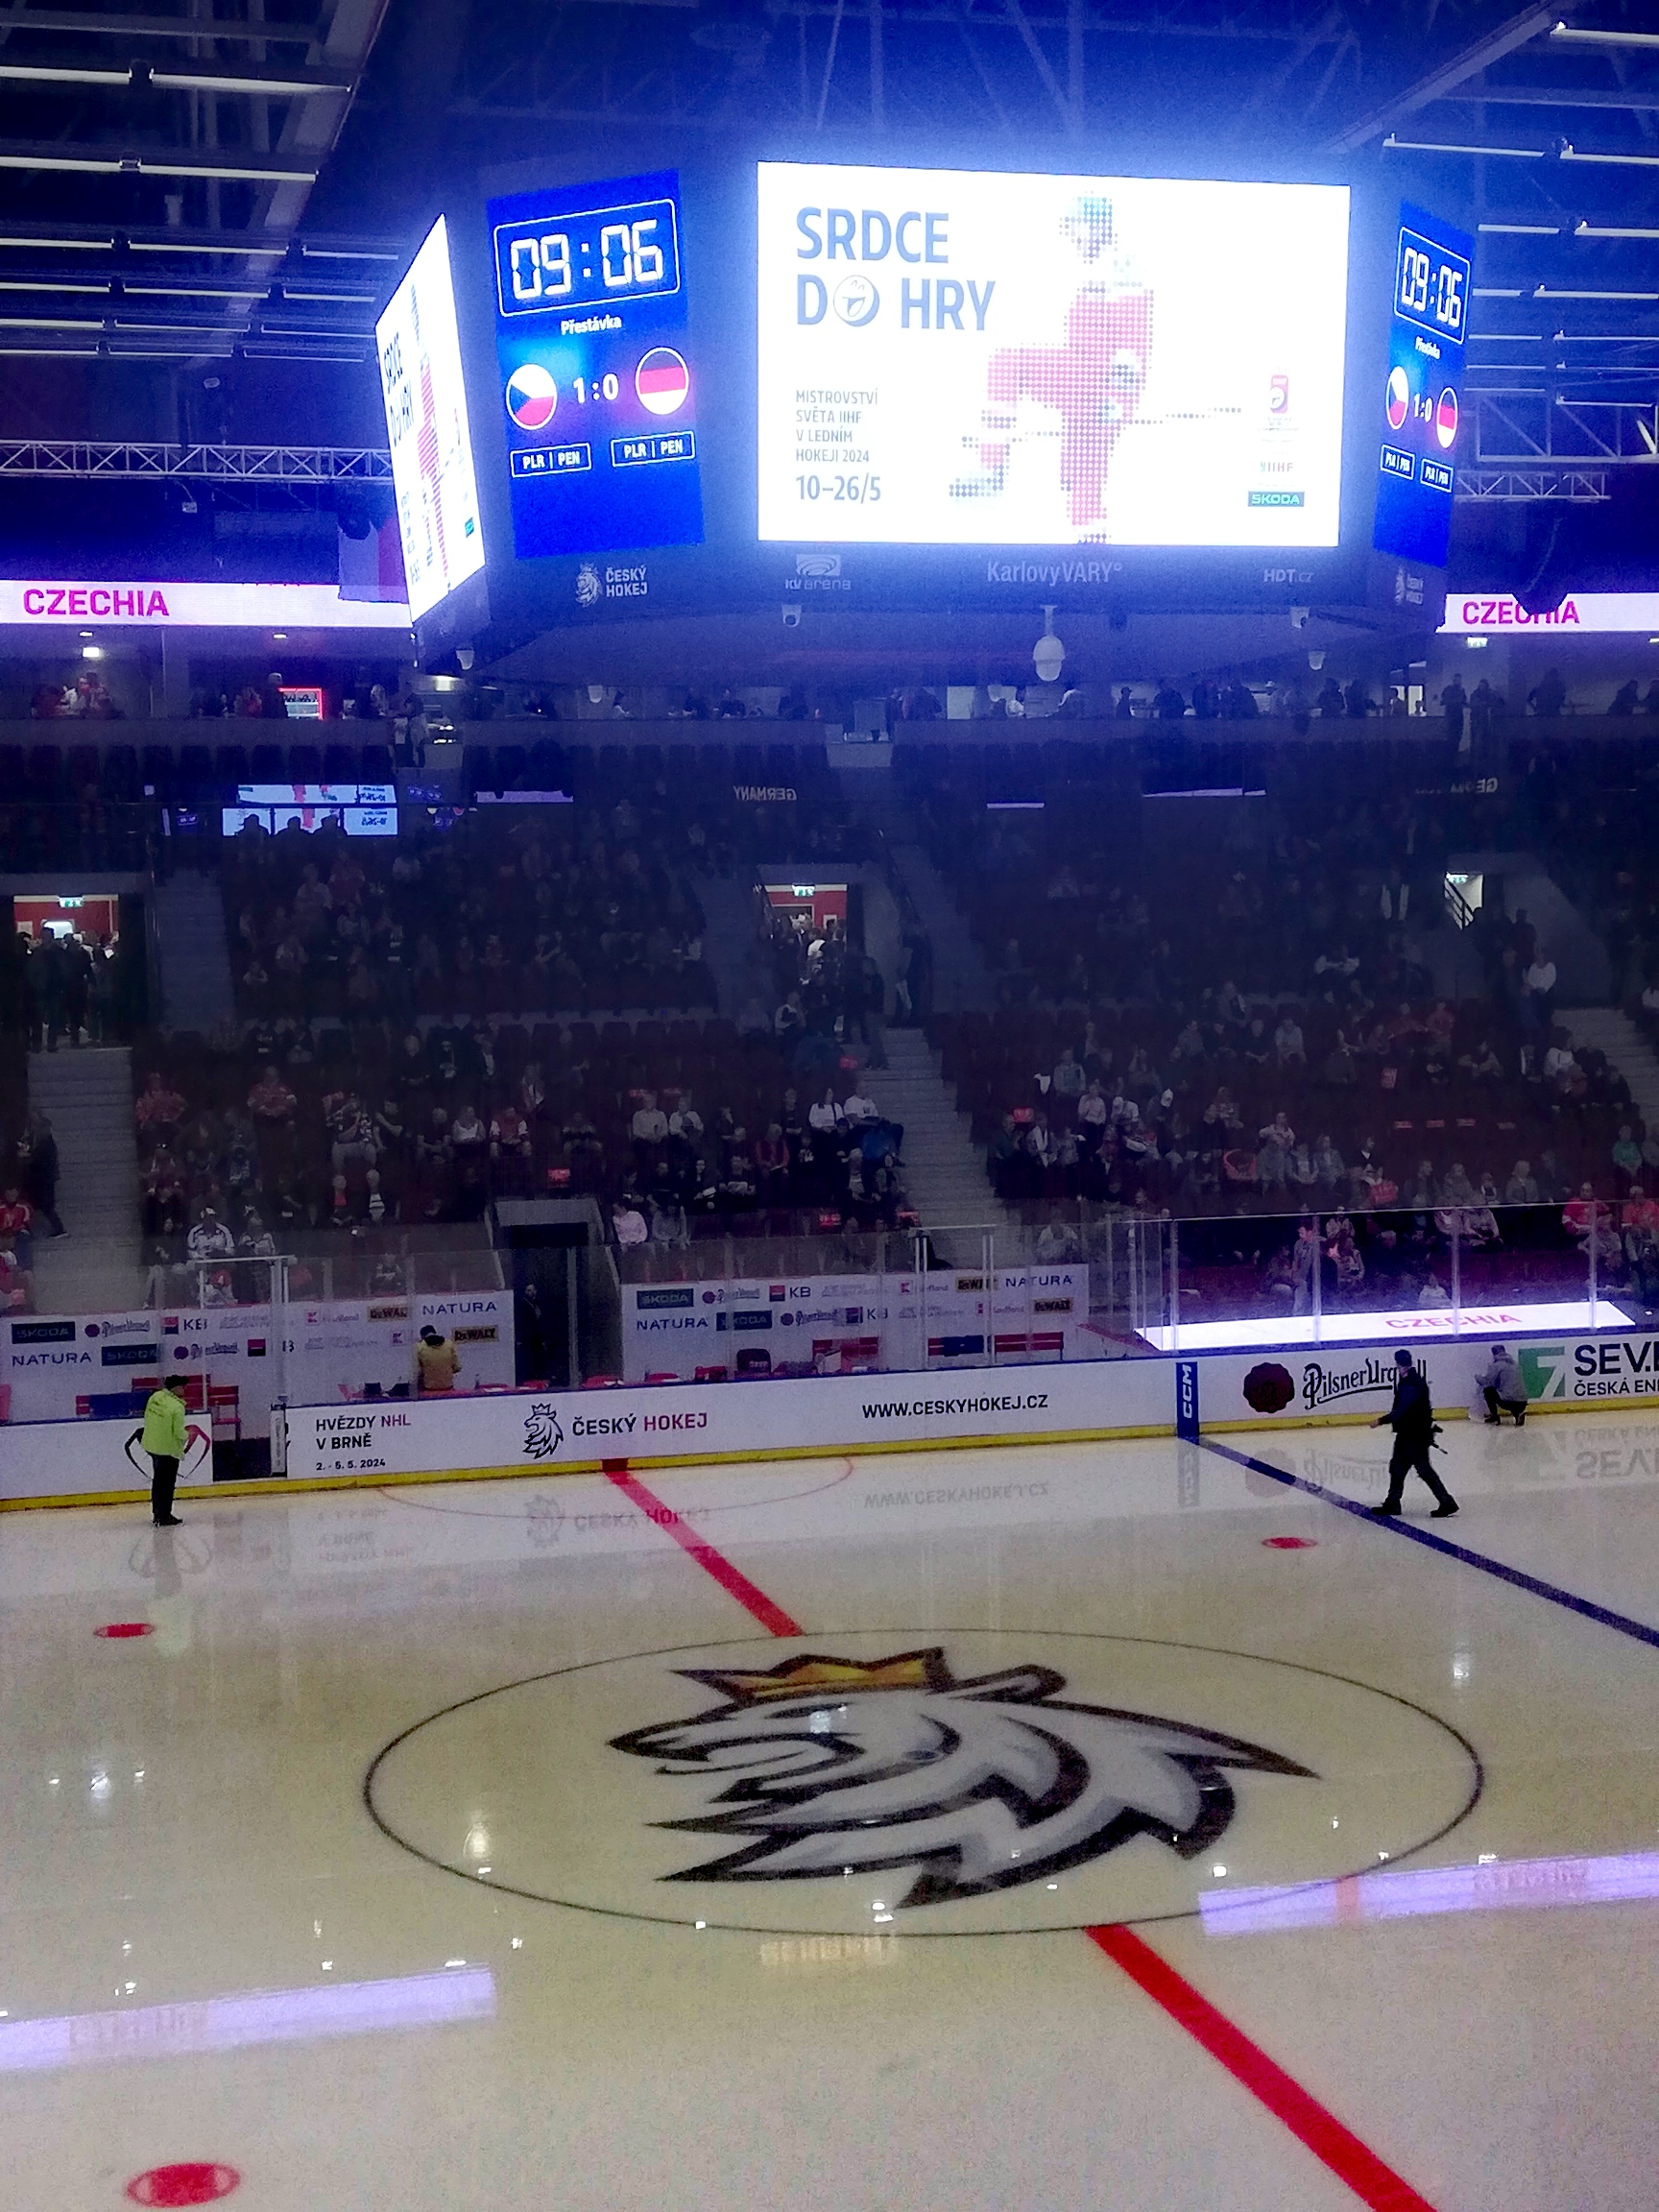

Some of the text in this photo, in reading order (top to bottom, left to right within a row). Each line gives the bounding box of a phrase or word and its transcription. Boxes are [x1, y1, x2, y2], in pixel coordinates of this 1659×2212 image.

[795, 205, 950, 264] SRDCE
[510, 219, 664, 300] 09:06
[1401, 247, 1463, 328] 09:06
[901, 276, 997, 331] HRY
[561, 315, 622, 335] Přestávka
[572, 373, 619, 404] 1:0
[795, 388, 878, 405] MISTROVSTVÍ
[795, 407, 862, 424] SVĚTA IIHF
[1413, 393, 1433, 423] 1:0
[795, 425, 853, 444] V LEDNÍM
[521, 451, 581, 469] PLR PEN
[623, 440, 684, 460] PLR PEN
[795, 447, 870, 464] HOKEJI 2024
[605, 564, 647, 584] ČESKÝ
[804, 578, 852, 590] arena
[605, 582, 648, 598] HOKEJ
[23, 589, 170, 617] CZECHIA
[1005, 1274, 1073, 1287] NATURA
[789, 1286, 811, 1299] KB
[422, 1301, 497, 1315] NATURA
[637, 1316, 709, 1331] NATURA
[1385, 1313, 1523, 1329] CZECHIA
[12, 1352, 92, 1367] NATURA
[1574, 1340, 1659, 1378] SEV.
[1181, 1363, 1193, 1420] CCM
[1302, 1357, 1427, 1410] Pilsner Urqll
[1574, 1377, 1630, 1398] ČESKÁ
[862, 1394, 1048, 1419] WWW.CESKYHOKEJ.CZ
[316, 1413, 412, 1432] HVĚZDY NHL
[572, 1412, 709, 1437] ČESKÝ HOKEJ
[315, 1431, 373, 1451] V BRNĚ
[360, 1457, 386, 1469] 2024
